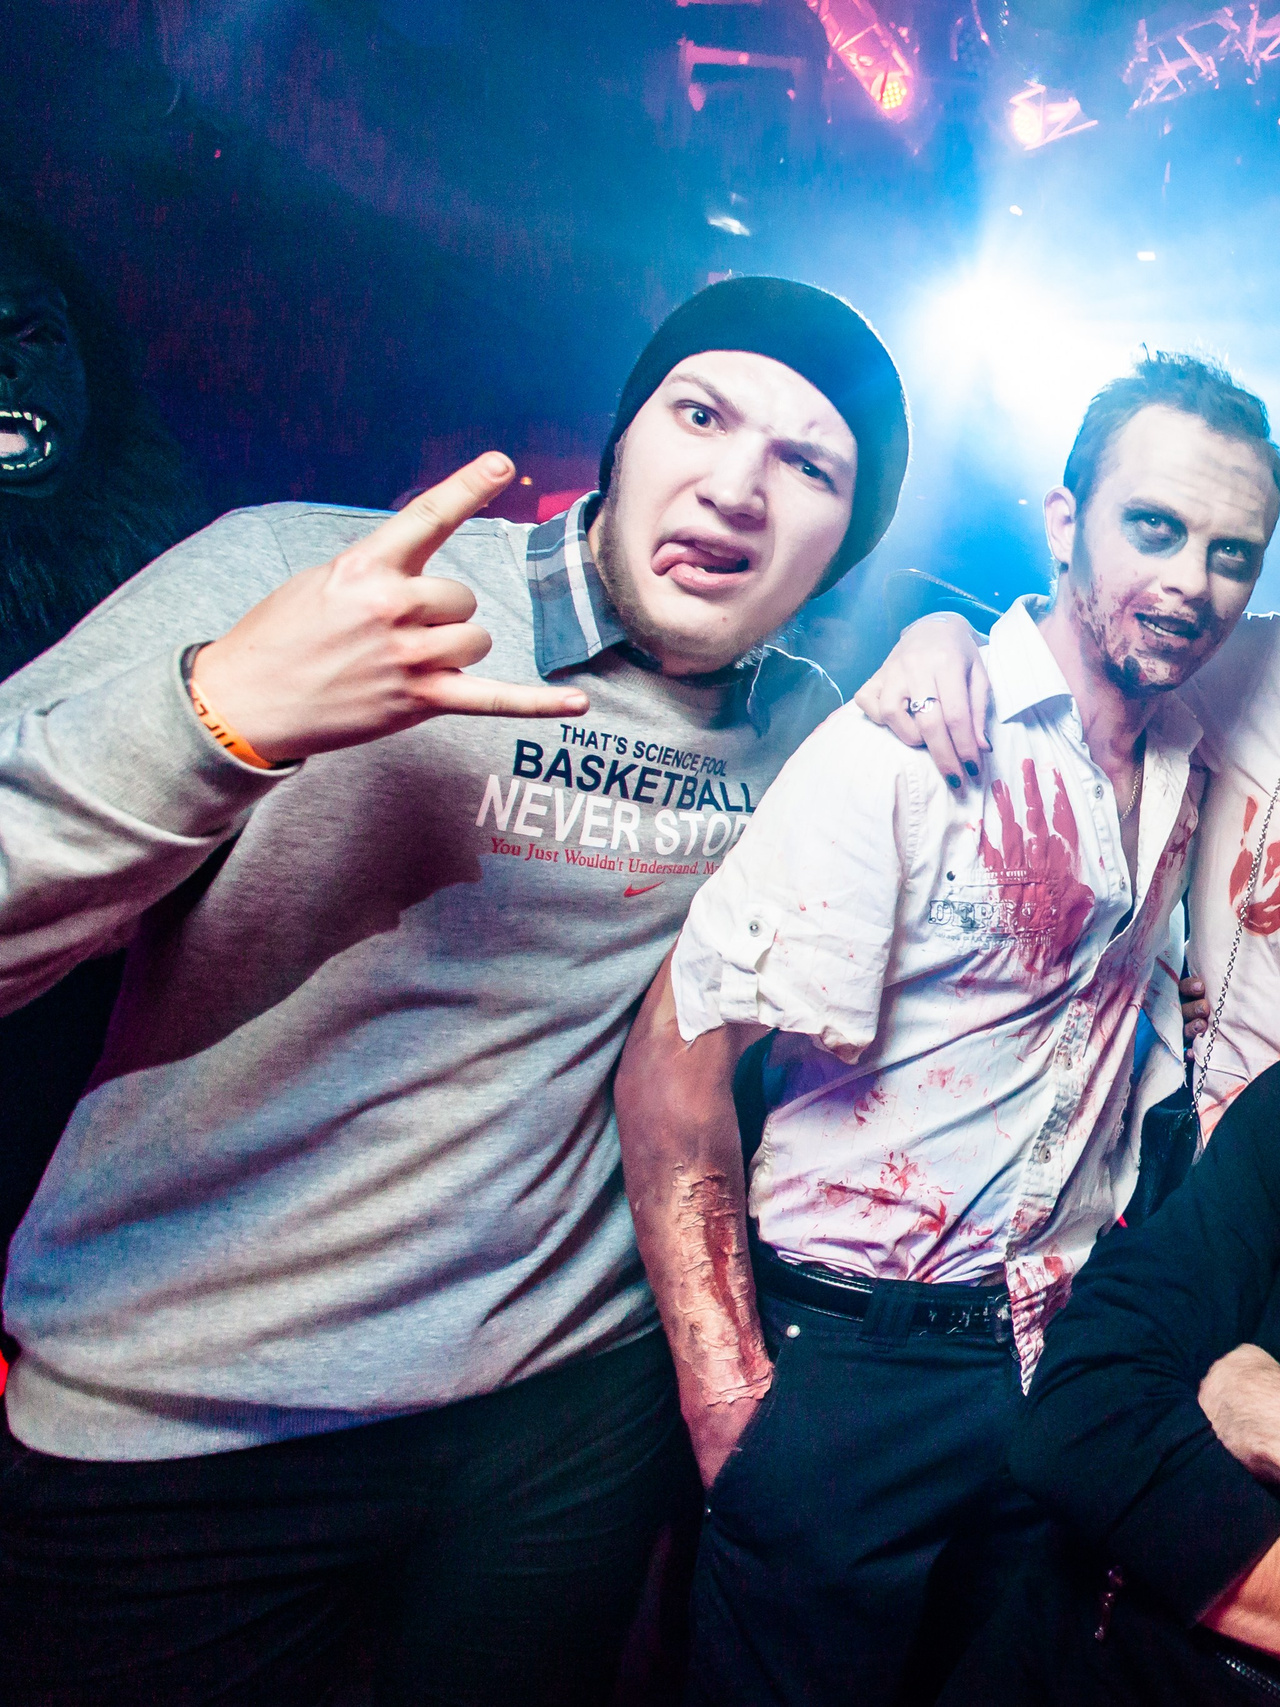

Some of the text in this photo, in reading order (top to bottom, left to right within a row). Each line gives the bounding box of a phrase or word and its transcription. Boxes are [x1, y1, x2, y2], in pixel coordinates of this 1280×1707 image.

[560, 724, 628, 755] THAT'S
[513, 739, 757, 813] BASKETBALL
[475, 774, 640, 853] NEVER
[490, 837, 521, 856] You
[524, 843, 558, 863] Just
[564, 849, 624, 872] Wouldn't
